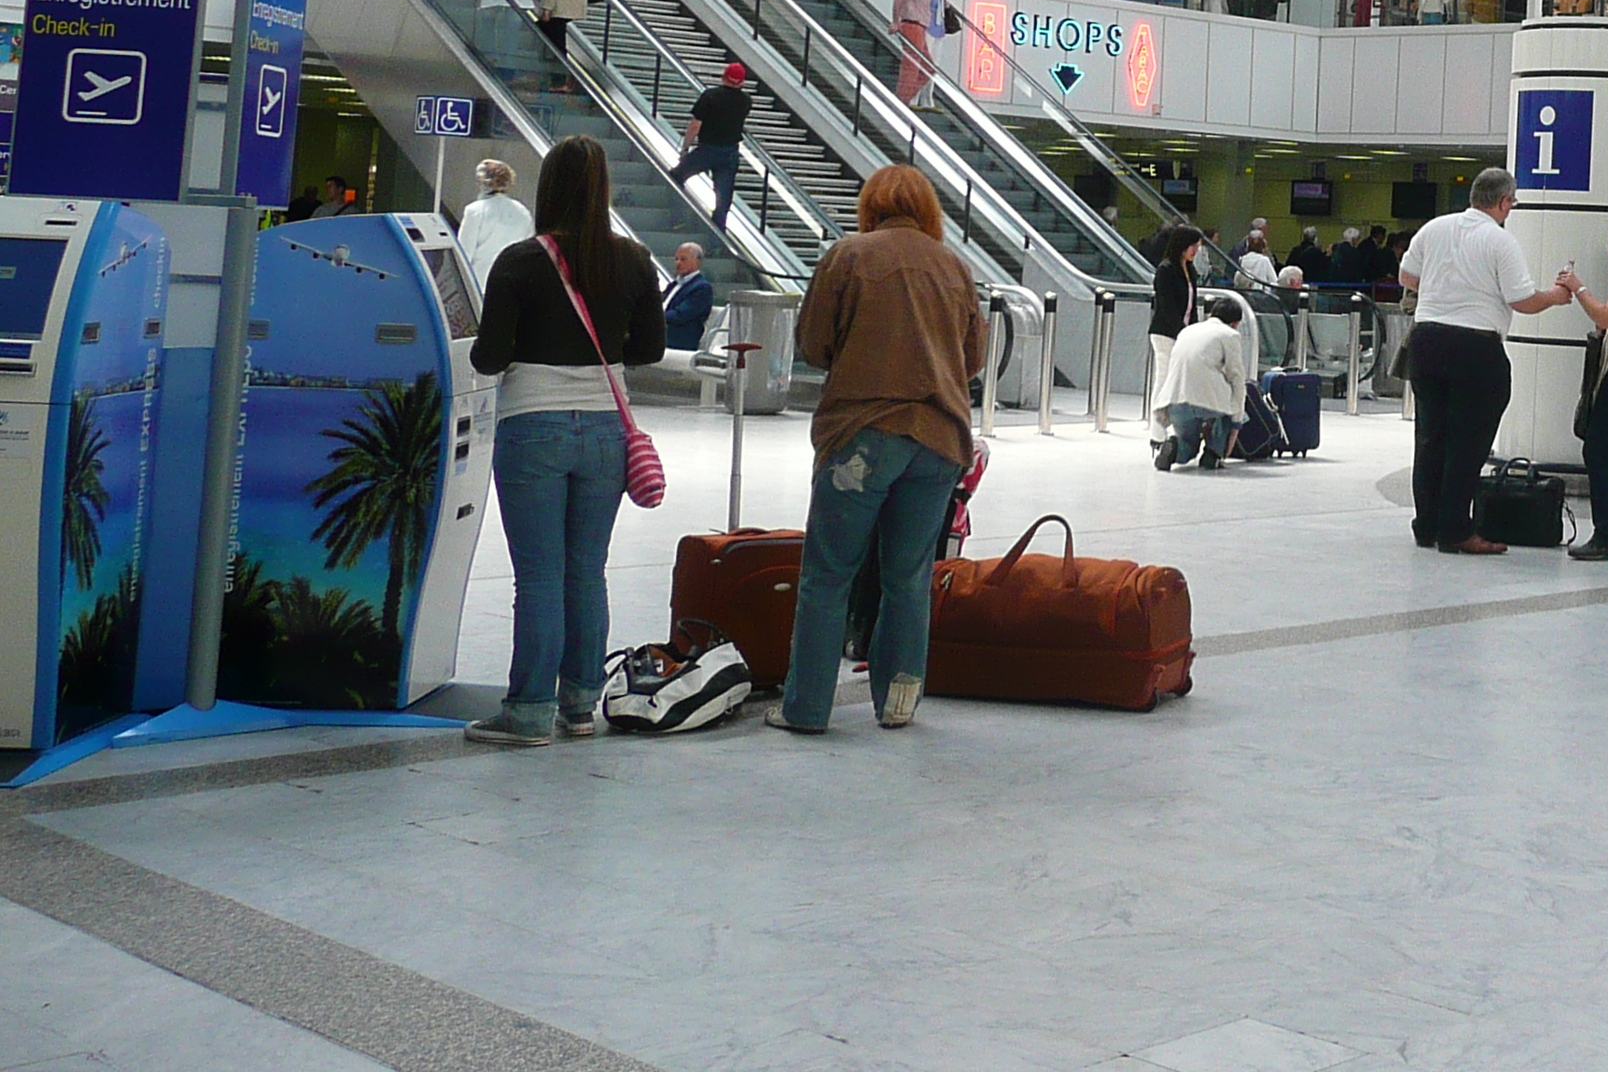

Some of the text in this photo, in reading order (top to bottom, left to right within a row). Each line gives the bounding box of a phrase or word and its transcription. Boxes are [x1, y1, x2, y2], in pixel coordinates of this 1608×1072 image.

[32, 14, 116, 38] Check-in
[249, 29, 280, 55] Check-in
[979, 12, 996, 81] BAR
[1010, 11, 1124, 57] SHOPS
[1136, 31, 1150, 94] TABAC
[138, 346, 158, 453] EXPRESS
